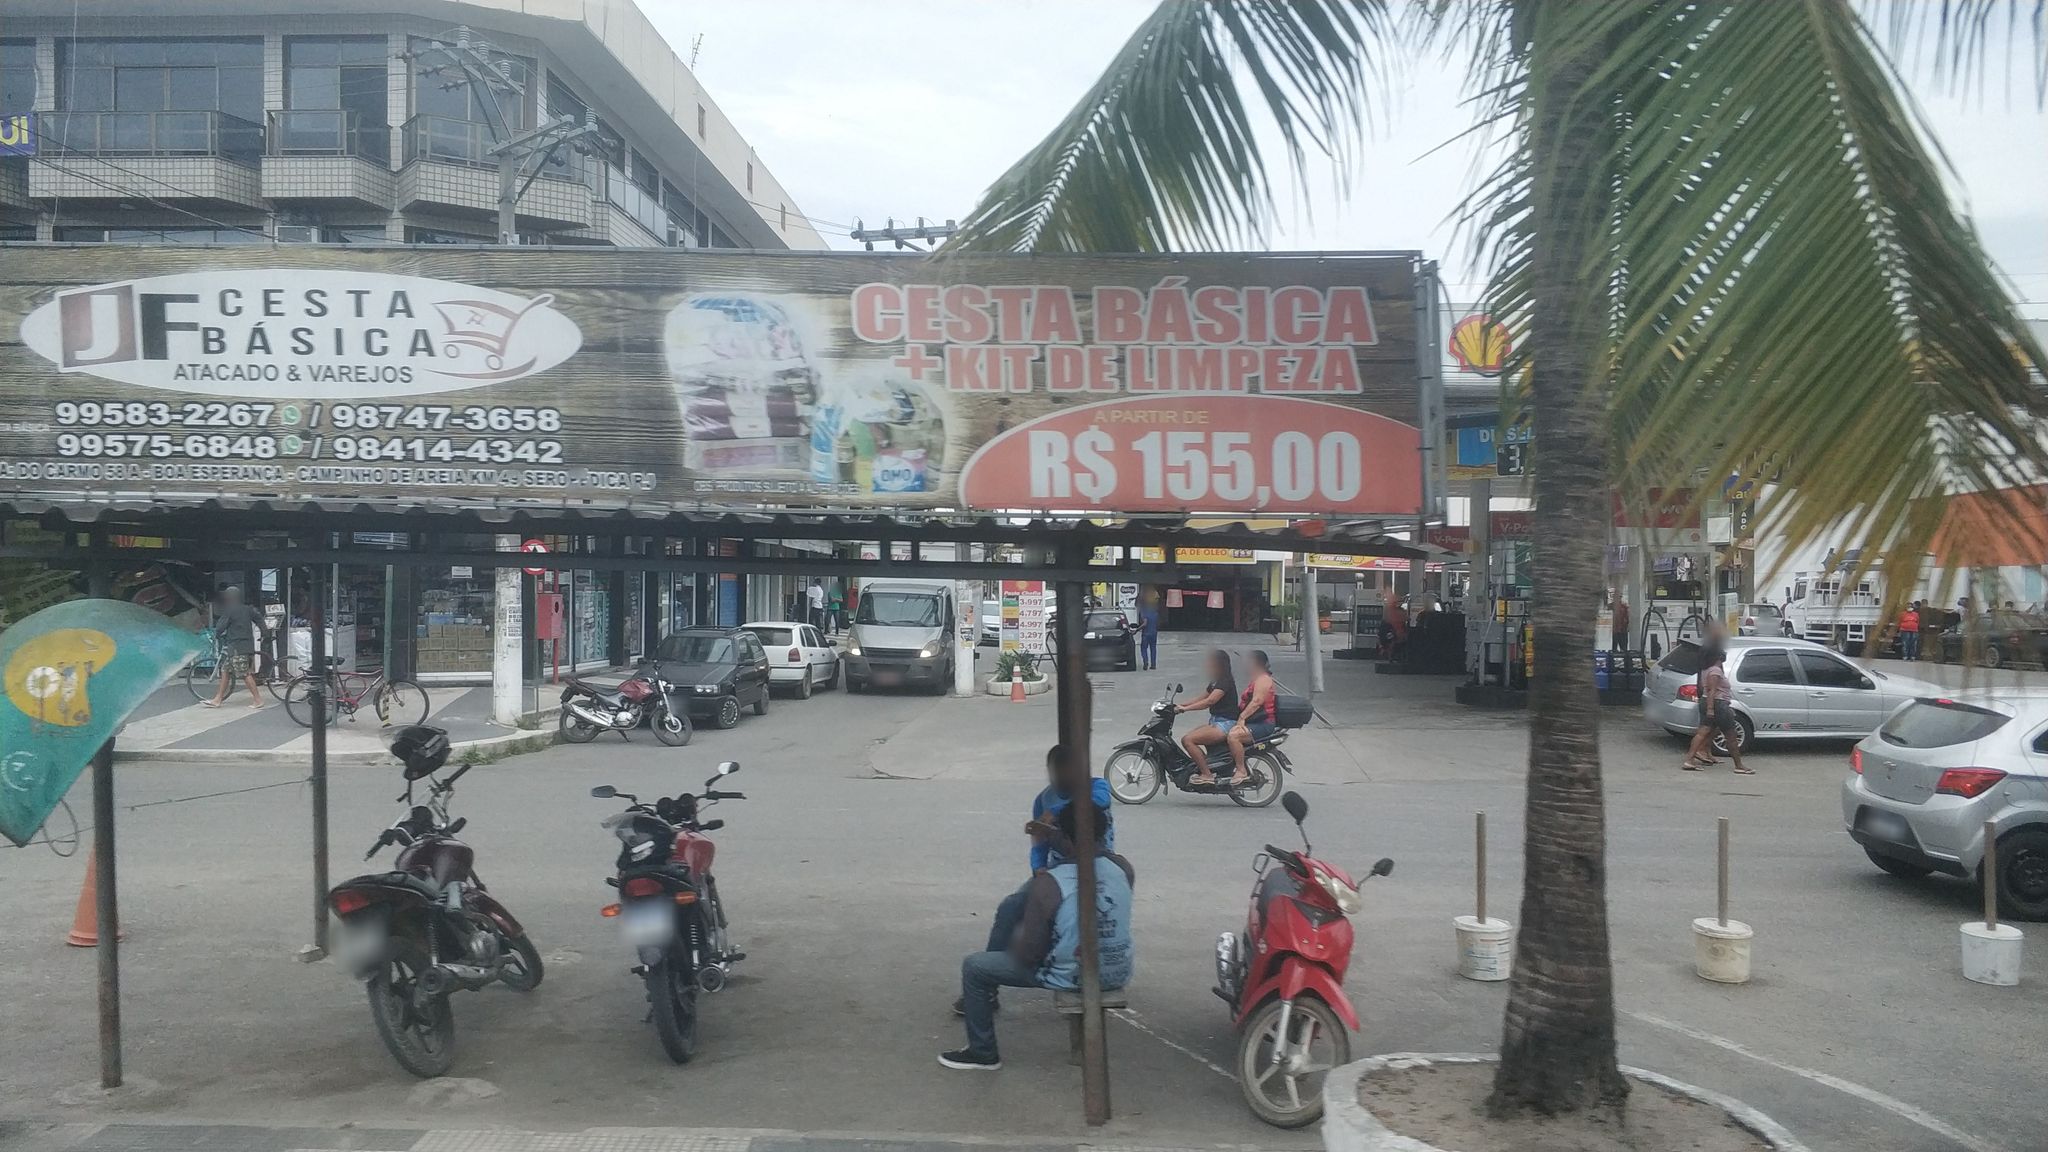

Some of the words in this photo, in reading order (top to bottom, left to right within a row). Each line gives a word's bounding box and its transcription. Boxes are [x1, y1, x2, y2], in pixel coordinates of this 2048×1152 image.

[218, 288, 416, 318] CESTA
[850, 282, 1082, 344] CESTA
[1094, 276, 1378, 345] BÁSICA
[202, 316, 437, 359] BÁSICA
[173, 364, 279, 384] ATACADO
[286, 364, 301, 384] &
[309, 364, 413, 385] VAREJOS
[944, 344, 1038, 393] KIT
[1046, 345, 1121, 393] DE
[1126, 345, 1364, 395] LIMPEZA
[55, 401, 276, 427] 99583-2267
[331, 403, 562, 431] 98747-3658
[1094, 410, 1107, 425] A
[1109, 410, 1178, 425] PARTIR
[1184, 410, 1209, 425] DE
[56, 432, 278, 458] 99575-6848
[332, 436, 564, 463] 98414-4342
[1479, 425, 1536, 443] DISEL
[43, 461, 102, 481] CARMO
[188, 463, 286, 485] ESPERANÇA
[387, 467, 413, 485] DE
[1028, 424, 1118, 504] R$
[1131, 430, 1362, 508] 155,00
